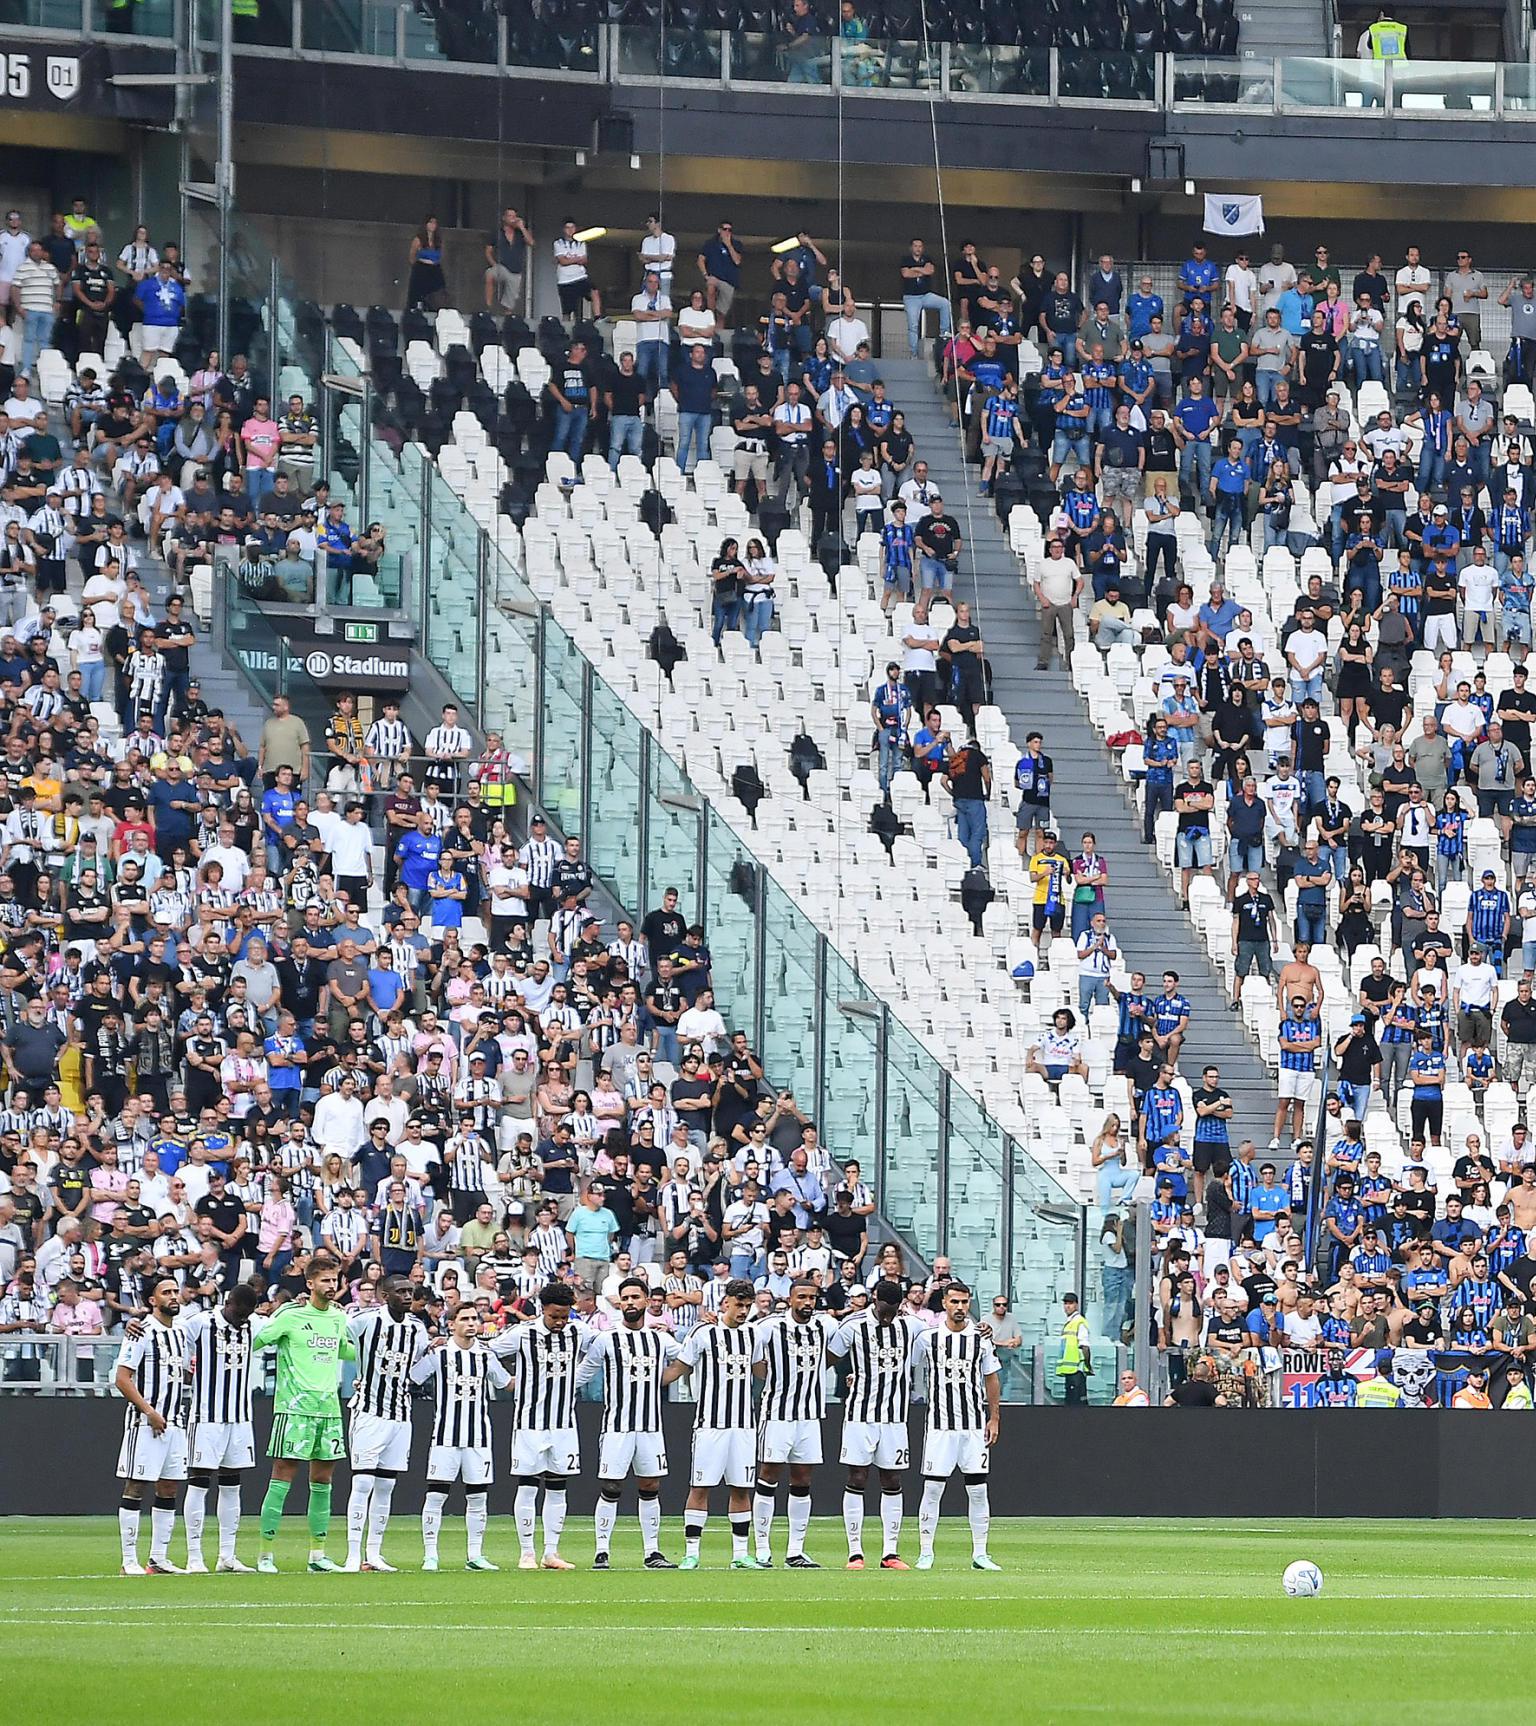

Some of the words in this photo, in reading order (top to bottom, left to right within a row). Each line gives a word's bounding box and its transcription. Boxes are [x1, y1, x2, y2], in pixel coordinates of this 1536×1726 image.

[52, 65, 73, 86] 01
[333, 655, 408, 677] Stadium
[216, 1342, 248, 1355] Jeep
[308, 1333, 338, 1350] Jeep
[375, 1346, 408, 1363] Jeep
[537, 1350, 572, 1363] Jeep
[718, 1351, 752, 1365] Jeep
[788, 1344, 821, 1357] Jeep
[870, 1346, 903, 1359] Jeep
[623, 1354, 656, 1367] Jeep
[937, 1355, 972, 1369] Jeep
[1283, 1354, 1327, 1373] ROWE
[447, 1375, 482, 1387] Jeep
[332, 1438, 341, 1455] 2
[895, 1449, 909, 1466] 26
[981, 1453, 988, 1469] 2
[484, 1461, 492, 1477] 7
[745, 1466, 756, 1482] 17
